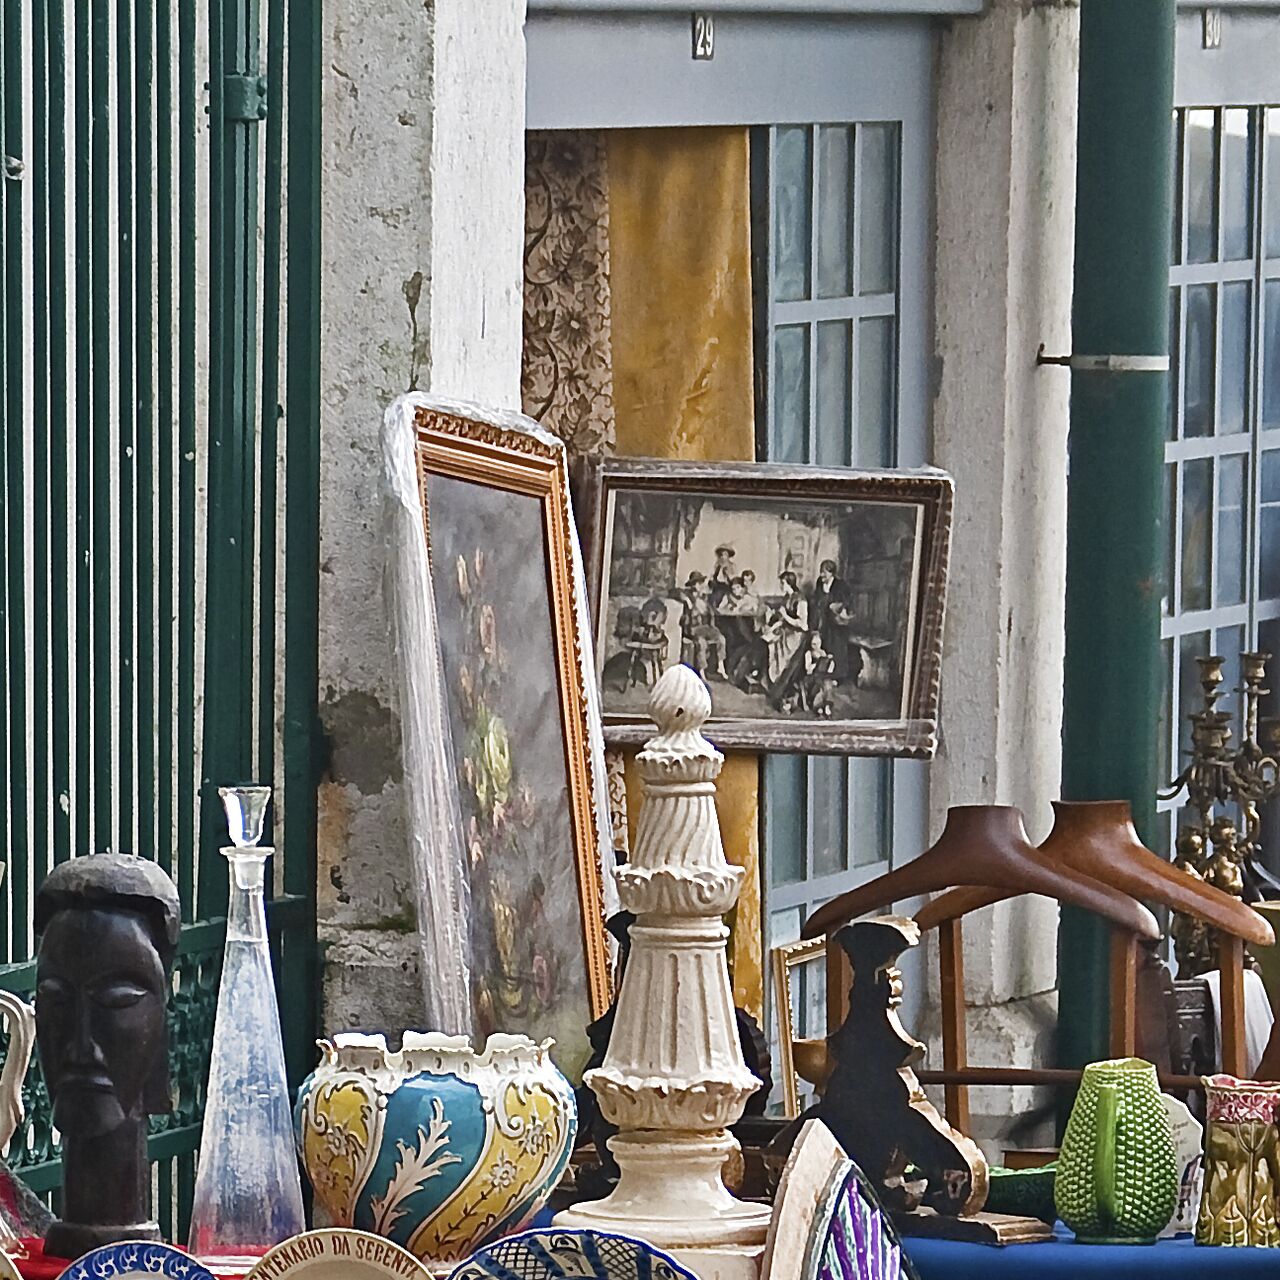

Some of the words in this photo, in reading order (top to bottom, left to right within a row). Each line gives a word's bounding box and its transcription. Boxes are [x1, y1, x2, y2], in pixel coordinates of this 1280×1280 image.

[695, 15, 714, 56] 29
[1205, 9, 1221, 48] 30
[331, 1235, 351, 1257] DA
